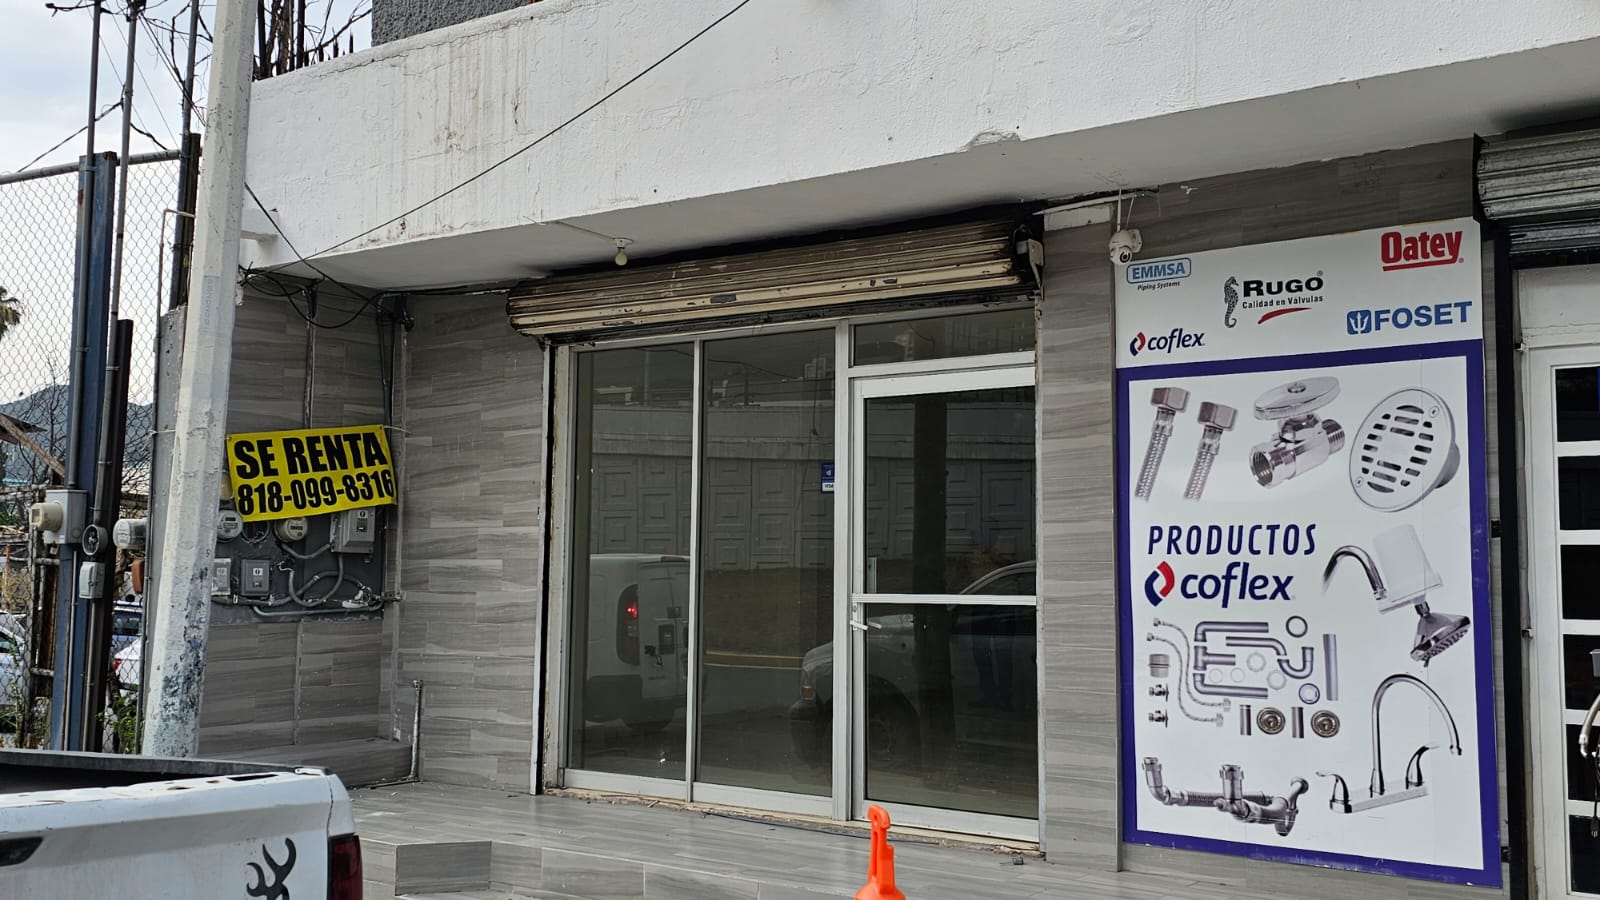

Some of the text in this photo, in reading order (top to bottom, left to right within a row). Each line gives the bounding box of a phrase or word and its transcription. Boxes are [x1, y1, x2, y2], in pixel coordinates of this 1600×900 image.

[1381, 231, 1463, 268] Oatey
[1132, 262, 1186, 280] EMMSA
[1137, 281, 1180, 291] Piping Systems
[1243, 277, 1323, 298] RUGO
[1242, 299, 1274, 309] Calidad
[1374, 301, 1473, 331] FOSET
[1147, 328, 1205, 354] coflex
[234, 432, 388, 479] SE RENTA
[238, 469, 394, 516] 818-099-8316
[1148, 523, 1317, 556] PRODUCTOS
[1181, 561, 1294, 609] coflex
